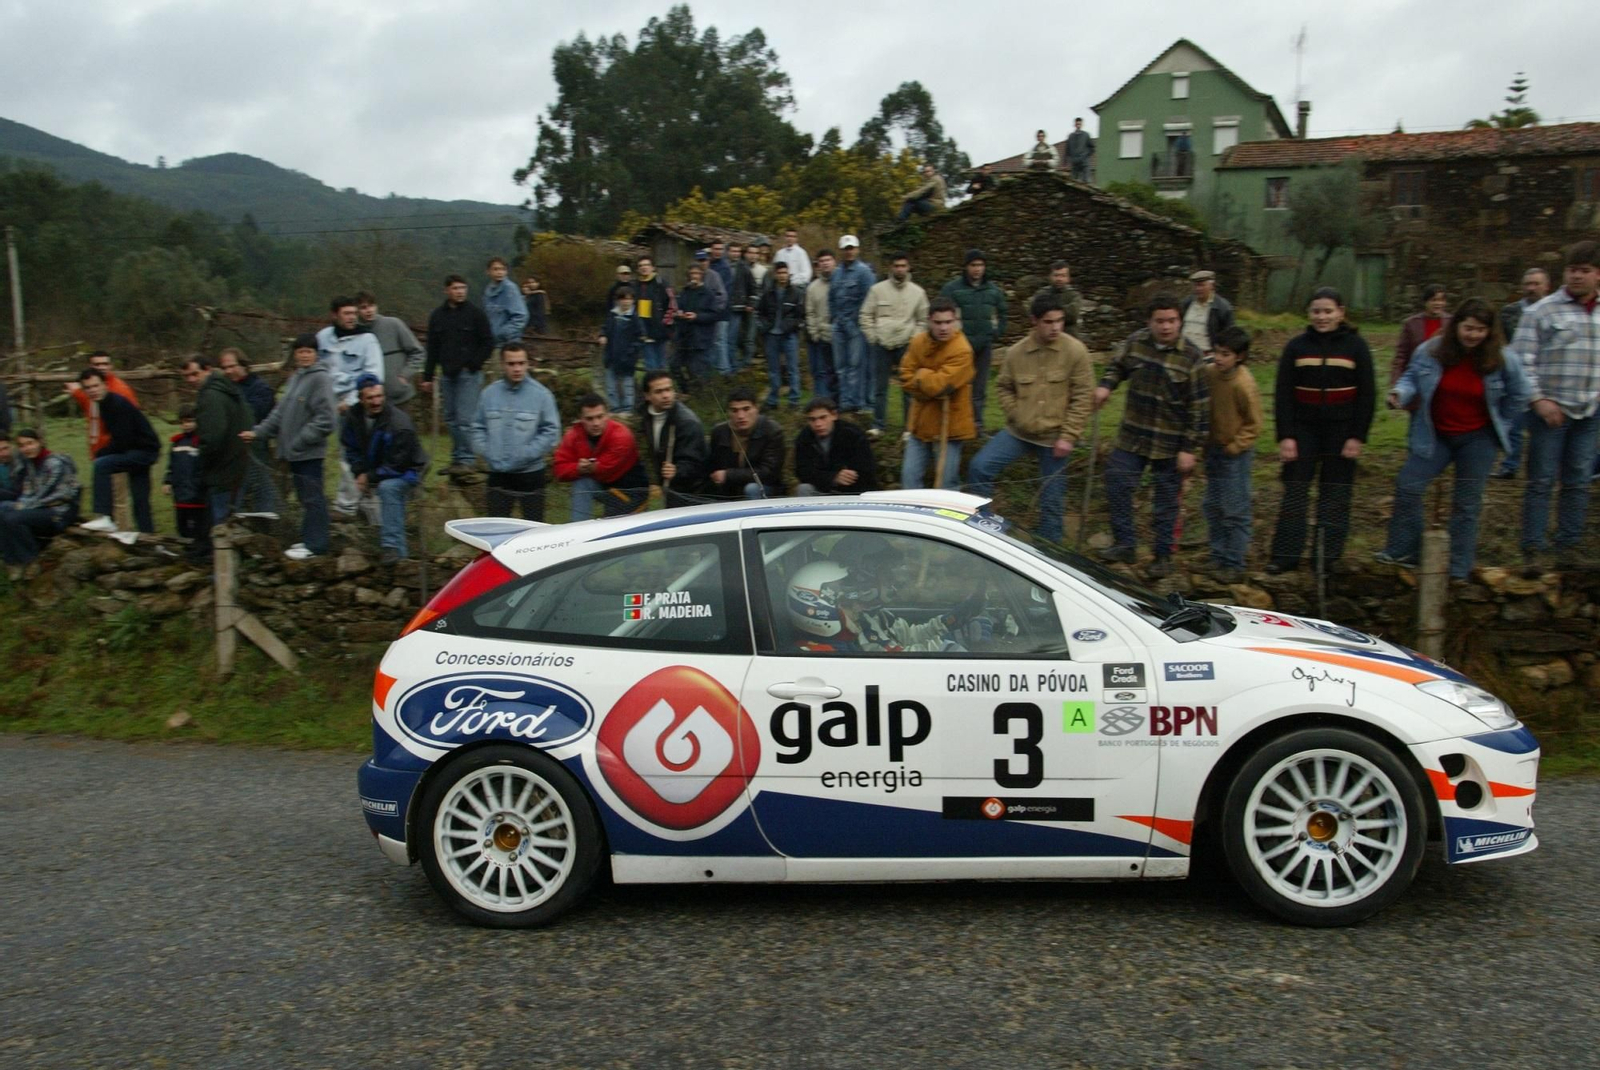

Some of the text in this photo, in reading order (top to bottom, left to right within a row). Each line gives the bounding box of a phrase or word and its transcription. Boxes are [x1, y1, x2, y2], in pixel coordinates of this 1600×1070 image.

[515, 541, 570, 554] ROCKPORT
[643, 591, 691, 606] F. PRATA
[643, 604, 713, 620] R. MADEIRA
[1078, 630, 1103, 641] Ford
[435, 650, 575, 667] Concessionários
[1113, 666, 1134, 675] Ford
[1168, 663, 1210, 673] SACOOR
[947, 669, 1089, 692] CASINO DA PÓVOA
[1110, 675, 1138, 683] Credit
[430, 685, 558, 739] Ford
[1070, 708, 1087, 727] A
[769, 685, 932, 765] galp
[1149, 706, 1218, 736] BPN
[993, 702, 1044, 789] 3
[1098, 739, 1122, 747] BANCO
[1170, 739, 1180, 747] DE
[821, 766, 923, 793] energia
[1007, 804, 1057, 814] galp energia
[1474, 831, 1528, 847] MICHELIN
